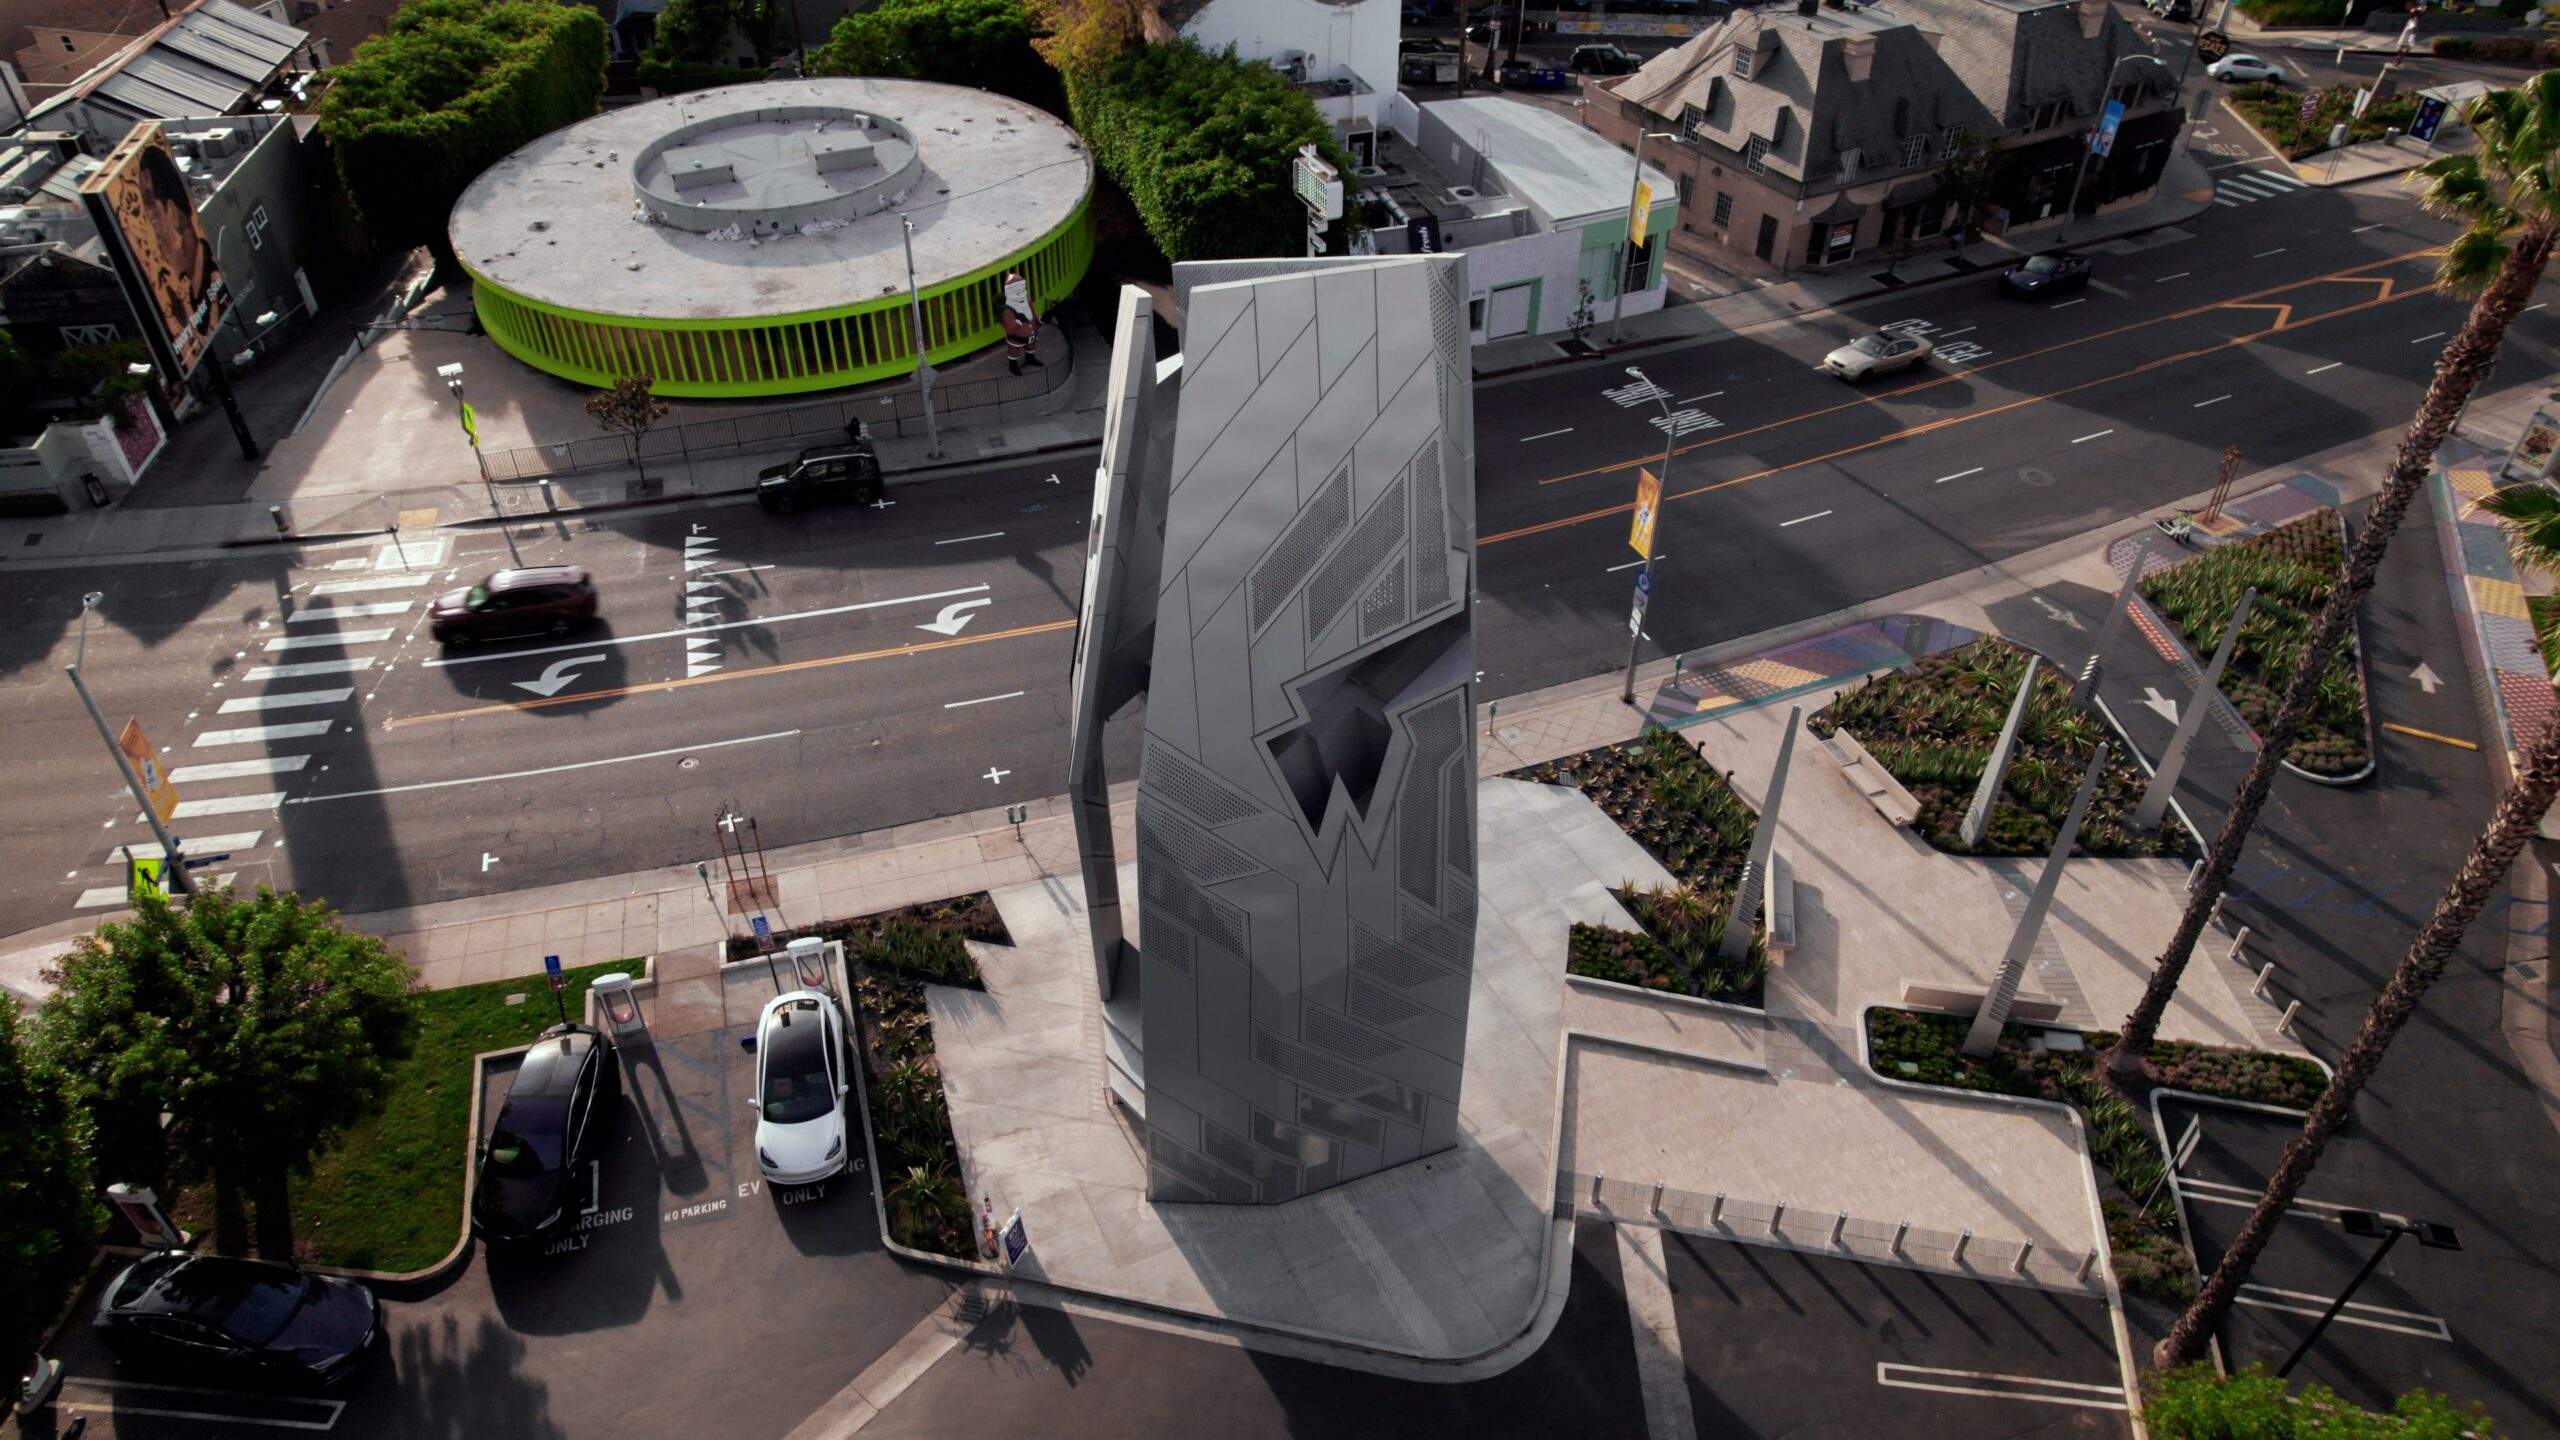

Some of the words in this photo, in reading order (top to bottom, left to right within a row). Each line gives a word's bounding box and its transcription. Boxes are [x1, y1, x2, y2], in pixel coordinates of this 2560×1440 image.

[1880, 318, 1942, 336] PED
[1932, 341, 1993, 364] PED
[1601, 381, 1675, 408] XING
[1648, 408, 1726, 437] XING
[738, 1180, 760, 1198] EV
[782, 1185, 826, 1205] ONLY
[570, 1207, 633, 1232] ARGING
[664, 1211, 679, 1222] NO
[681, 1200, 726, 1219] PARKING
